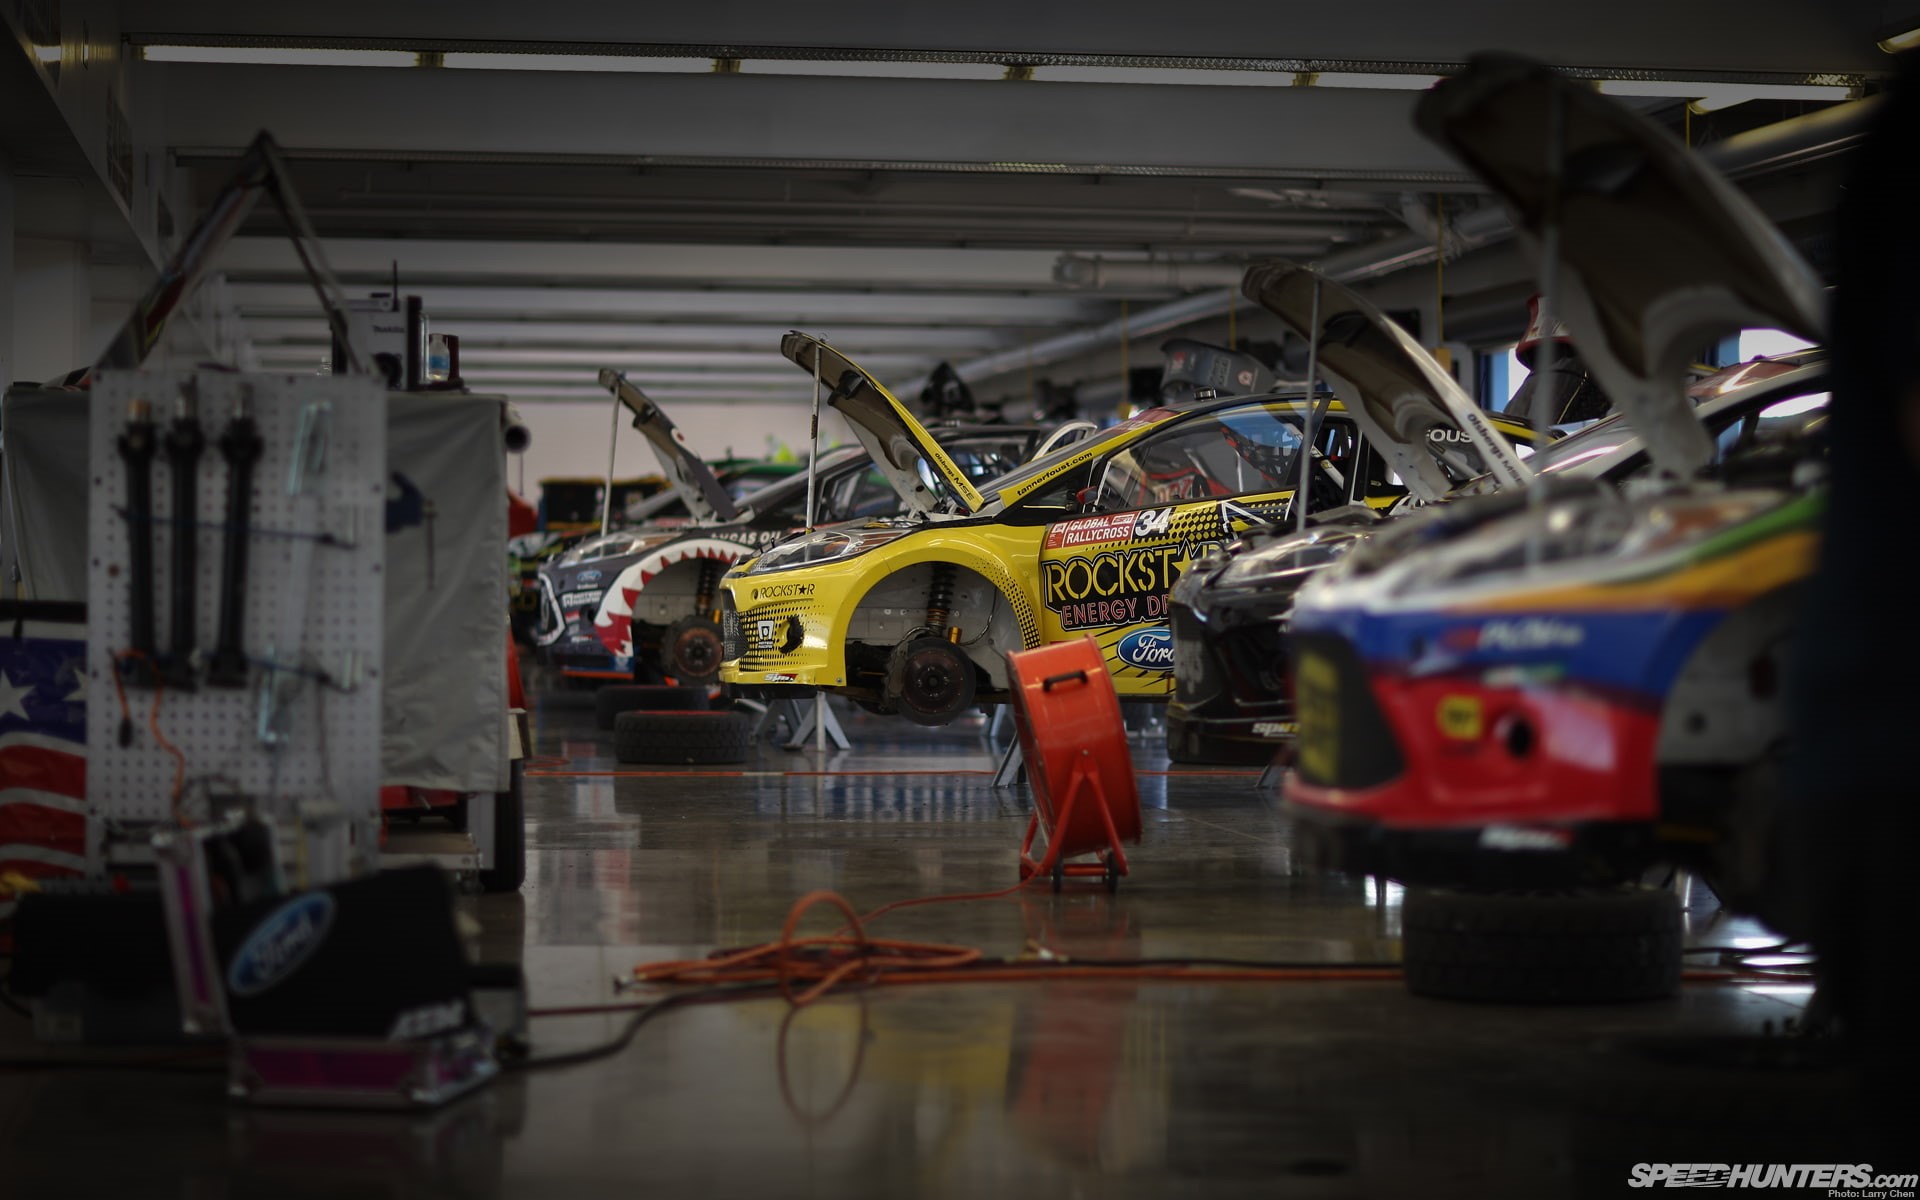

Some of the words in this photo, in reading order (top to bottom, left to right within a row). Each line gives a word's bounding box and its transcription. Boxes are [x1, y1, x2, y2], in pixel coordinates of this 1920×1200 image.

[1016, 451, 1094, 497] tannerfoust.com
[953, 476, 975, 501] MSE
[1065, 525, 1130, 544] RALLYCROSS
[1070, 517, 1110, 531] GLOBAL
[1134, 507, 1171, 537] 34
[759, 583, 816, 599] ROCKSTAR
[1062, 597, 1138, 626] ENERGY
